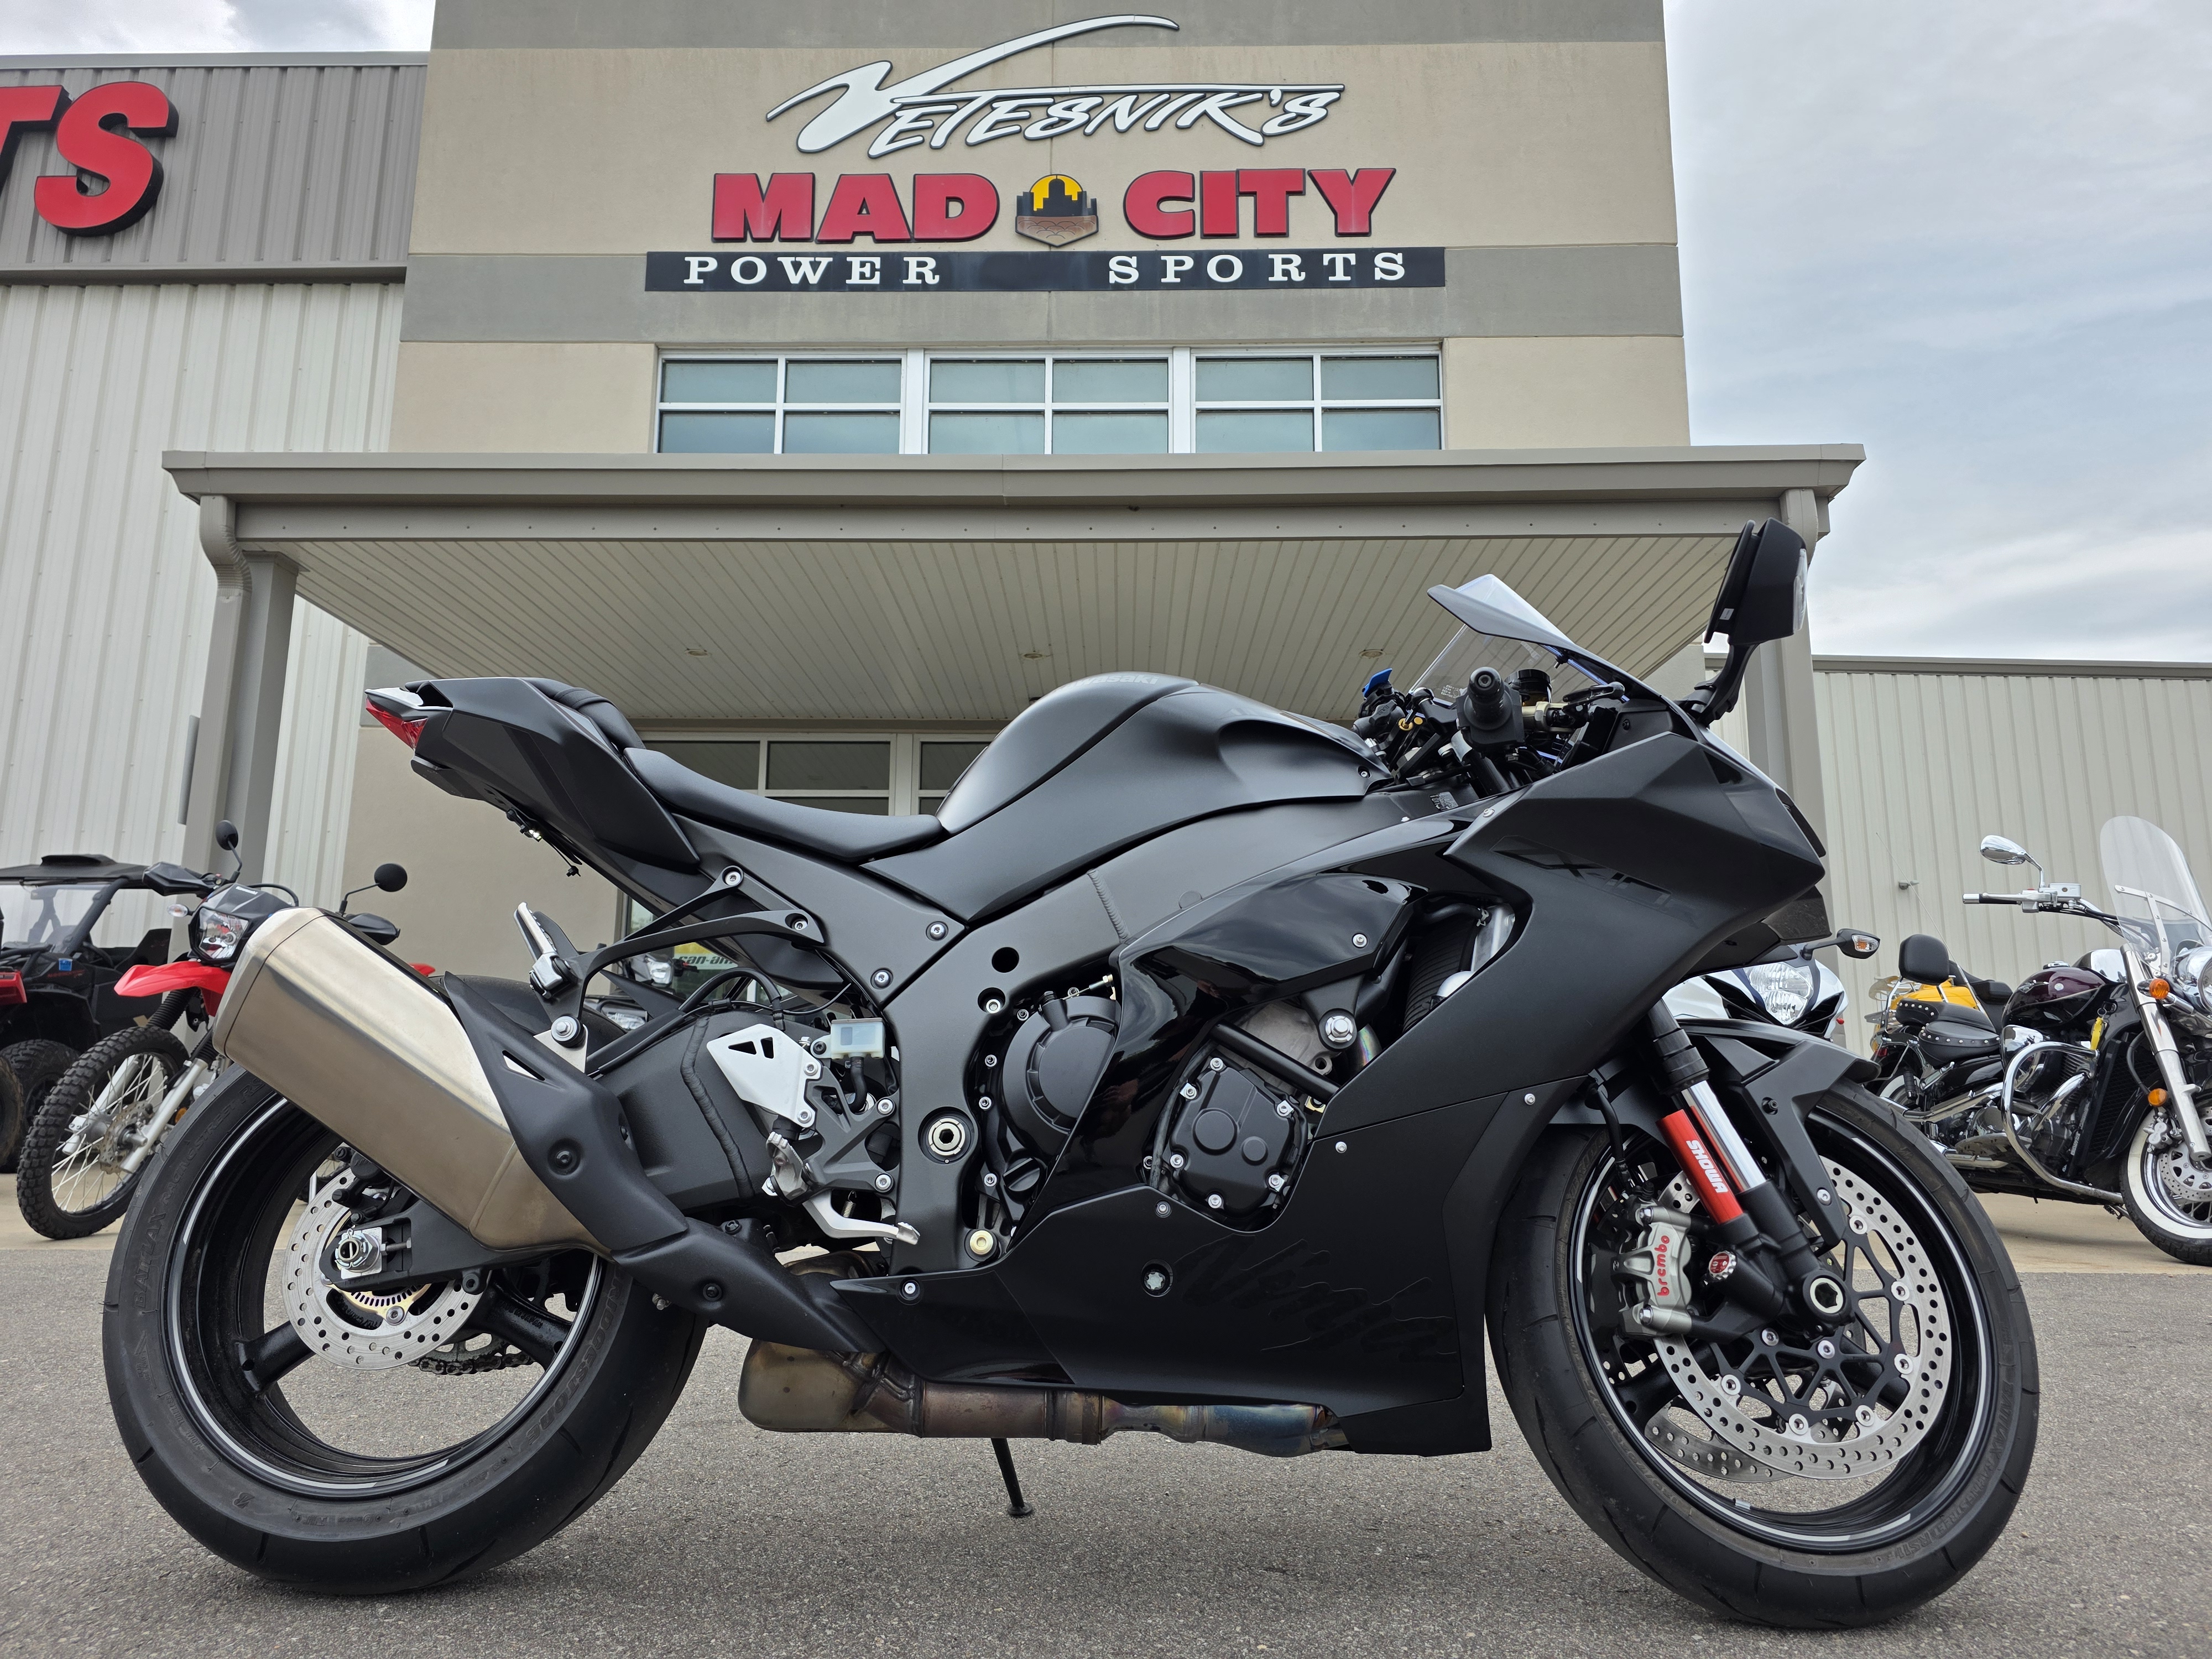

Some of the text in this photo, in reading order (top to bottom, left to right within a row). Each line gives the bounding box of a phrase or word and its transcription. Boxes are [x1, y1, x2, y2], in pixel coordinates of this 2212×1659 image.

[767, 14, 1345, 159] VETESNIK'S
[711, 168, 1396, 244] MAD CITY
[684, 252, 1405, 285] POWER SPORTS
[1055, 674, 1159, 689] awasaki
[1686, 1140, 1729, 1193] SHOWA
[1654, 1235, 1670, 1296] brembo
